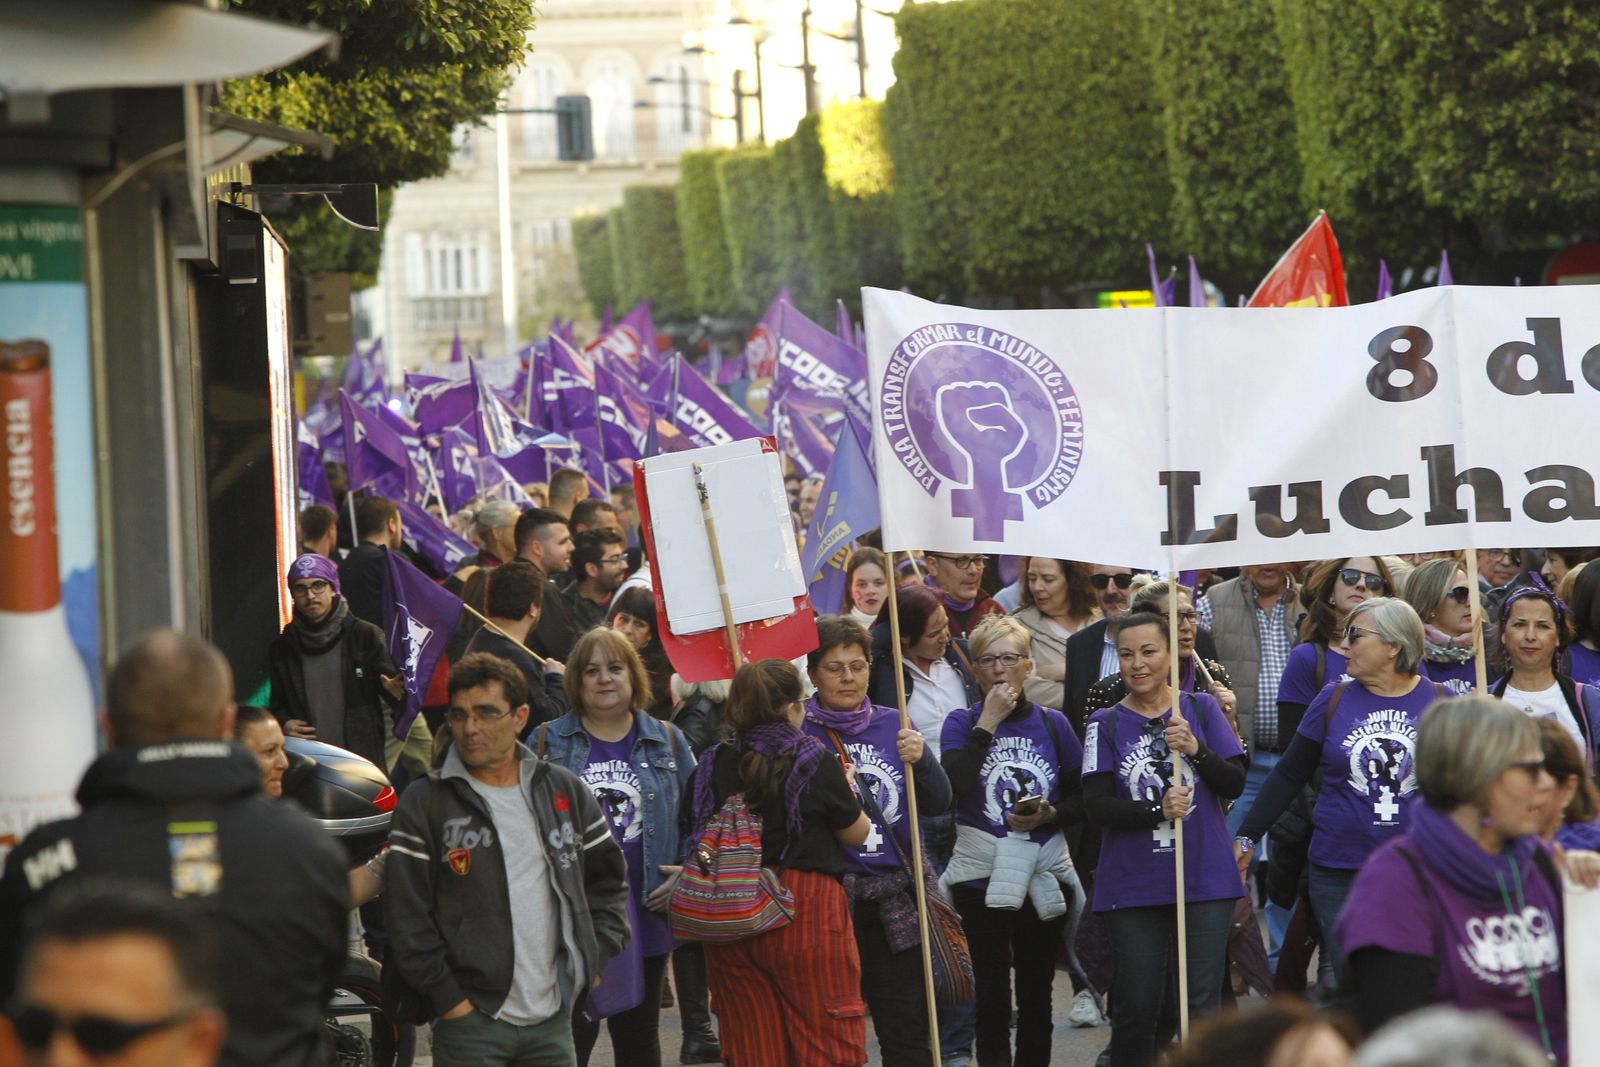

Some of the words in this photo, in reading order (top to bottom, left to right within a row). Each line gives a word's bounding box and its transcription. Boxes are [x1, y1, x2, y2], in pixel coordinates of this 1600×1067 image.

[966, 327, 985, 345] el
[1366, 325, 1438, 402] 8
[1486, 317, 1600, 396] d
[882, 324, 963, 436] TRANSFORMAR
[894, 436, 937, 490] PARA
[1035, 395, 1083, 502] FEMINISMO
[5, 398, 36, 537] esencia
[1366, 708, 1408, 724] JUNTAS
[995, 736, 1032, 752] JUNTAS
[1342, 721, 1386, 748] HACEMOS
[588, 760, 629, 774] JUNTAS
[860, 751, 903, 781] HISTORIA
[980, 749, 1015, 777] HACEMOS
[1017, 749, 1056, 781] HISTORIA
